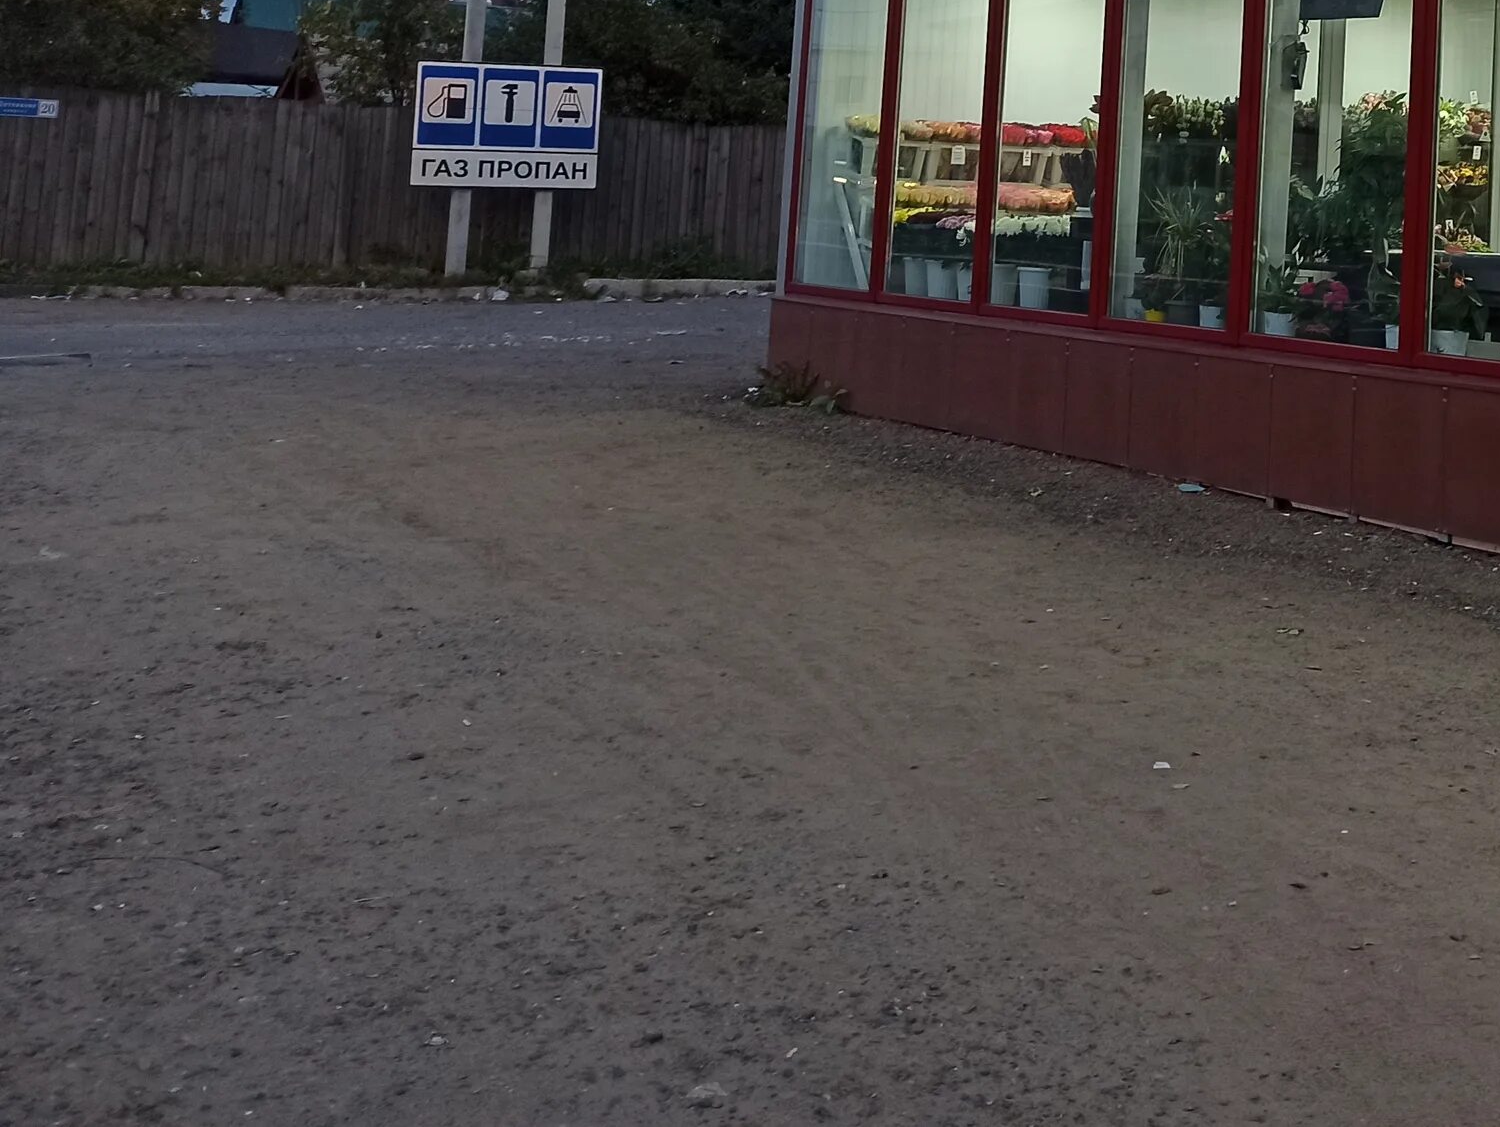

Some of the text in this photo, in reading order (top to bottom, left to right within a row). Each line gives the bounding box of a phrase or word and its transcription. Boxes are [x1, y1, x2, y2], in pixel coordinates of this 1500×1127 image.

[40, 103, 55, 114] 20
[421, 159, 588, 180] ГАЗ ПРОПАН
